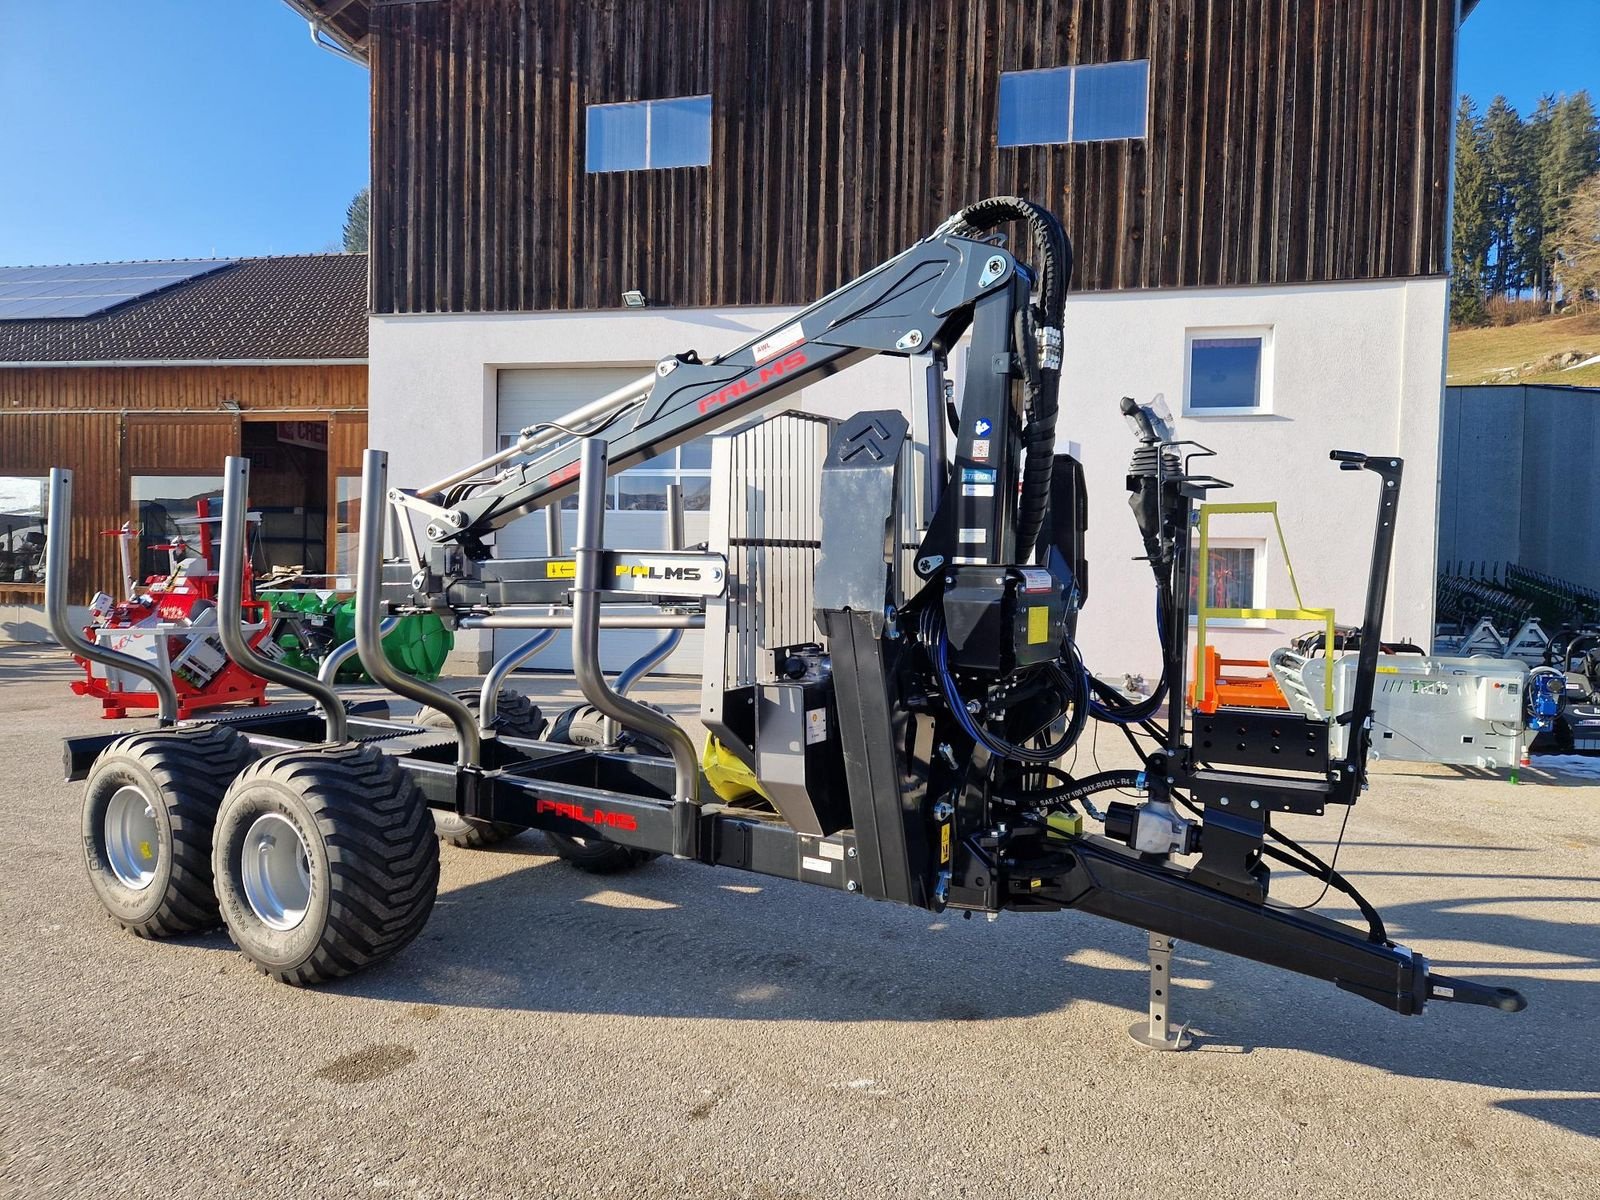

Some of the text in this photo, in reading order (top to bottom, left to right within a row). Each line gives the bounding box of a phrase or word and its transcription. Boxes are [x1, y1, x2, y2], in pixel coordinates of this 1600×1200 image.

[697, 350, 808, 415] PALMS
[615, 565, 701, 581] PALMS
[537, 799, 638, 831] PALMS
